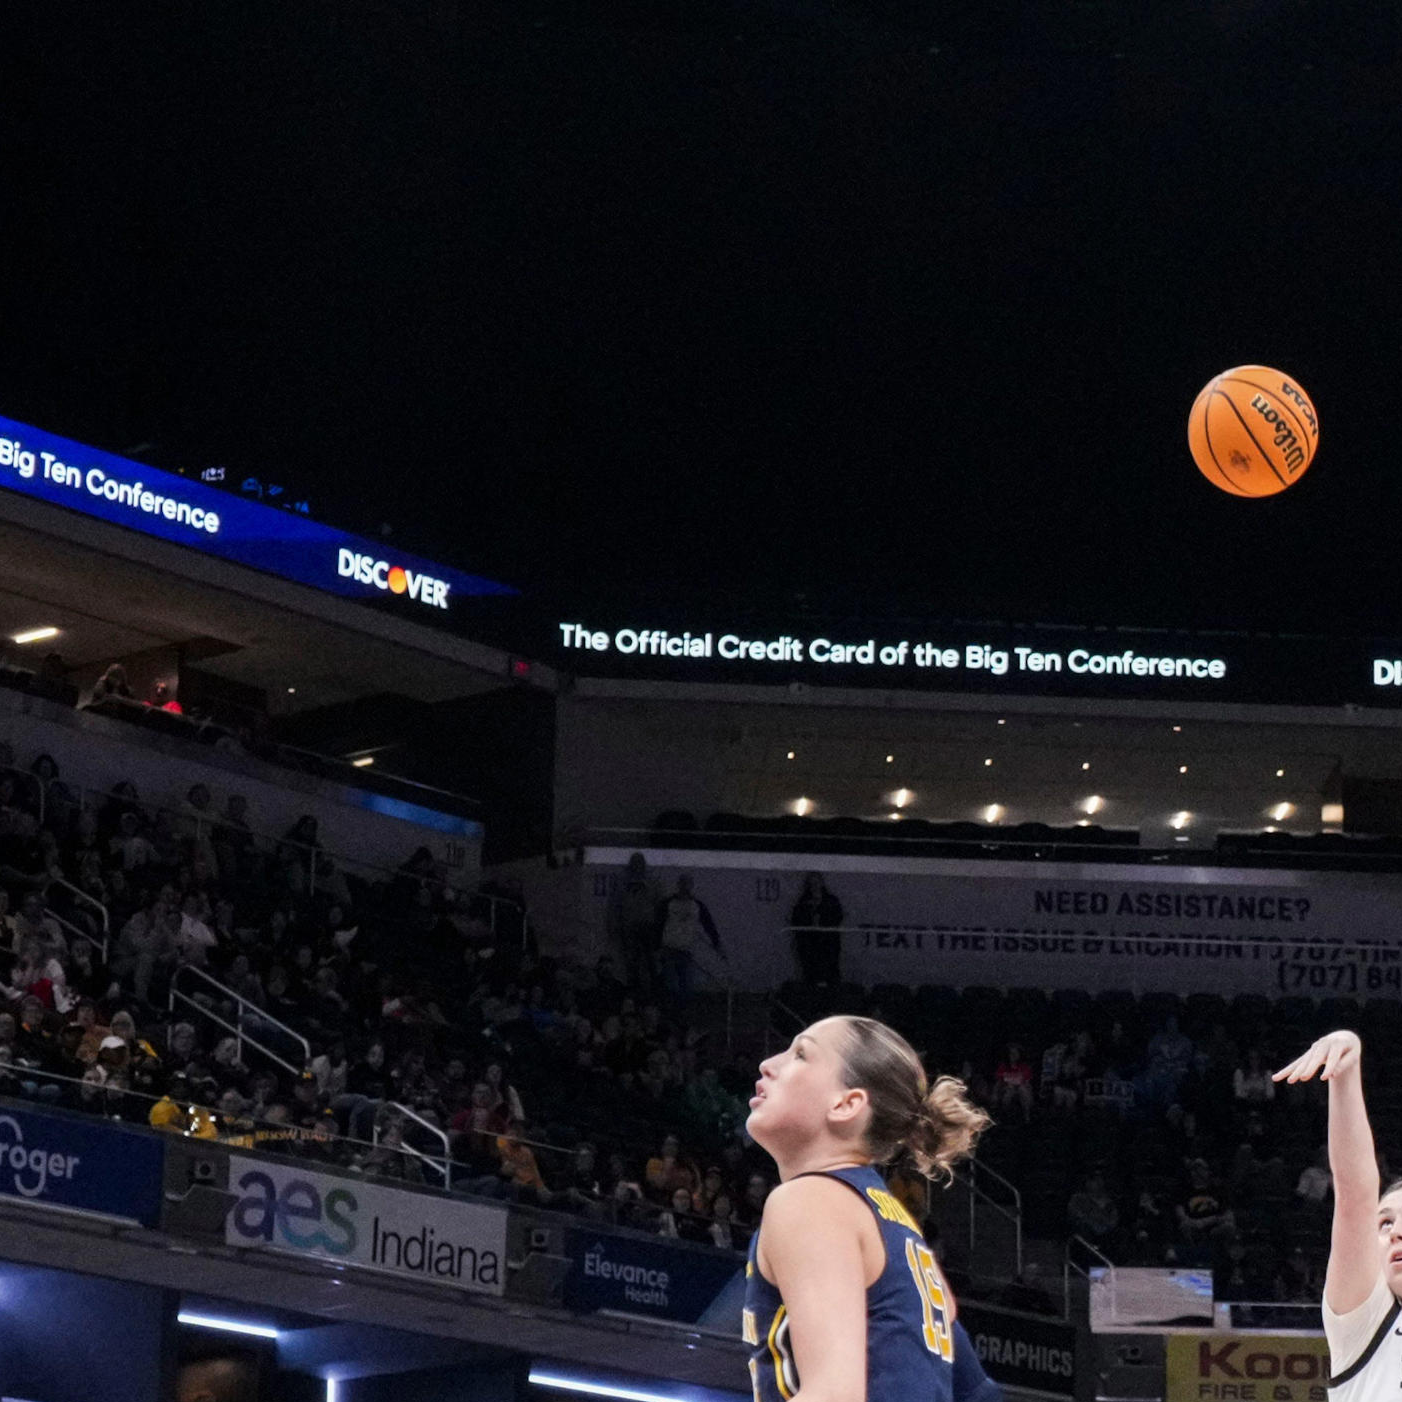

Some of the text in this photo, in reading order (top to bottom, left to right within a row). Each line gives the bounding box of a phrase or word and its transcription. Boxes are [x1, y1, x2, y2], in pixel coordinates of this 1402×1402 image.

[40, 452, 87, 487] Ten
[85, 469, 220, 533] Conference
[337, 548, 450, 609] DISCOVER
[559, 623, 1226, 679] The Official Credit Card of the Big Ten Conference
[1034, 890, 1312, 922] NEED ASSISTANCE?
[857, 923, 927, 950] TEXT
[932, 925, 987, 952] THE
[994, 928, 1078, 955] ISSUE
[1108, 931, 1244, 959] LOCATION
[232, 1170, 500, 1286] aes Indiana
[583, 1251, 671, 1290] Elevance
[624, 1284, 669, 1308] Health
[973, 1333, 1074, 1379] GRAPHICS
[1197, 1384, 1256, 1402] FIRE
[1272, 1384, 1292, 1402] &
